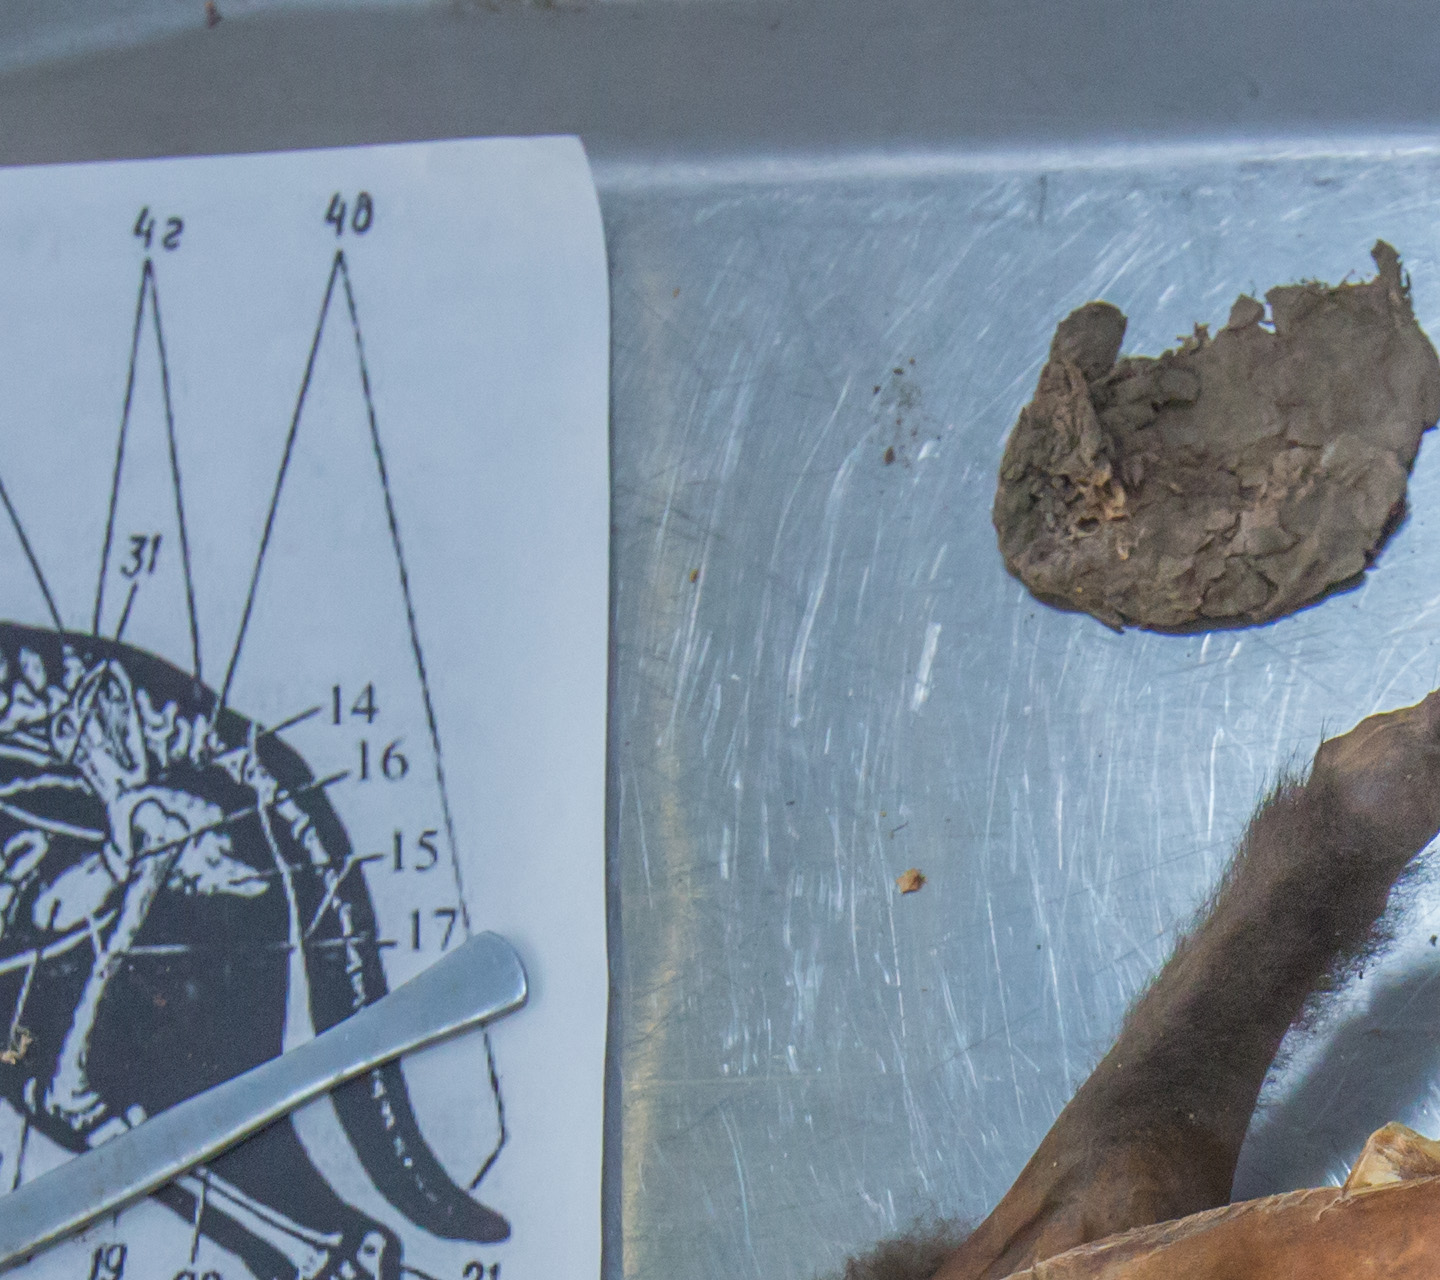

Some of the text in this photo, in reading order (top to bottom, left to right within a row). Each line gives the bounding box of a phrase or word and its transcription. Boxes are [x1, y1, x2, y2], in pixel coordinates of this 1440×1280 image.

[120, 533, 163, 580] 31
[332, 682, 380, 726] 14
[358, 738, 410, 782] 16
[393, 830, 439, 873] 15
[413, 908, 456, 952] 17
